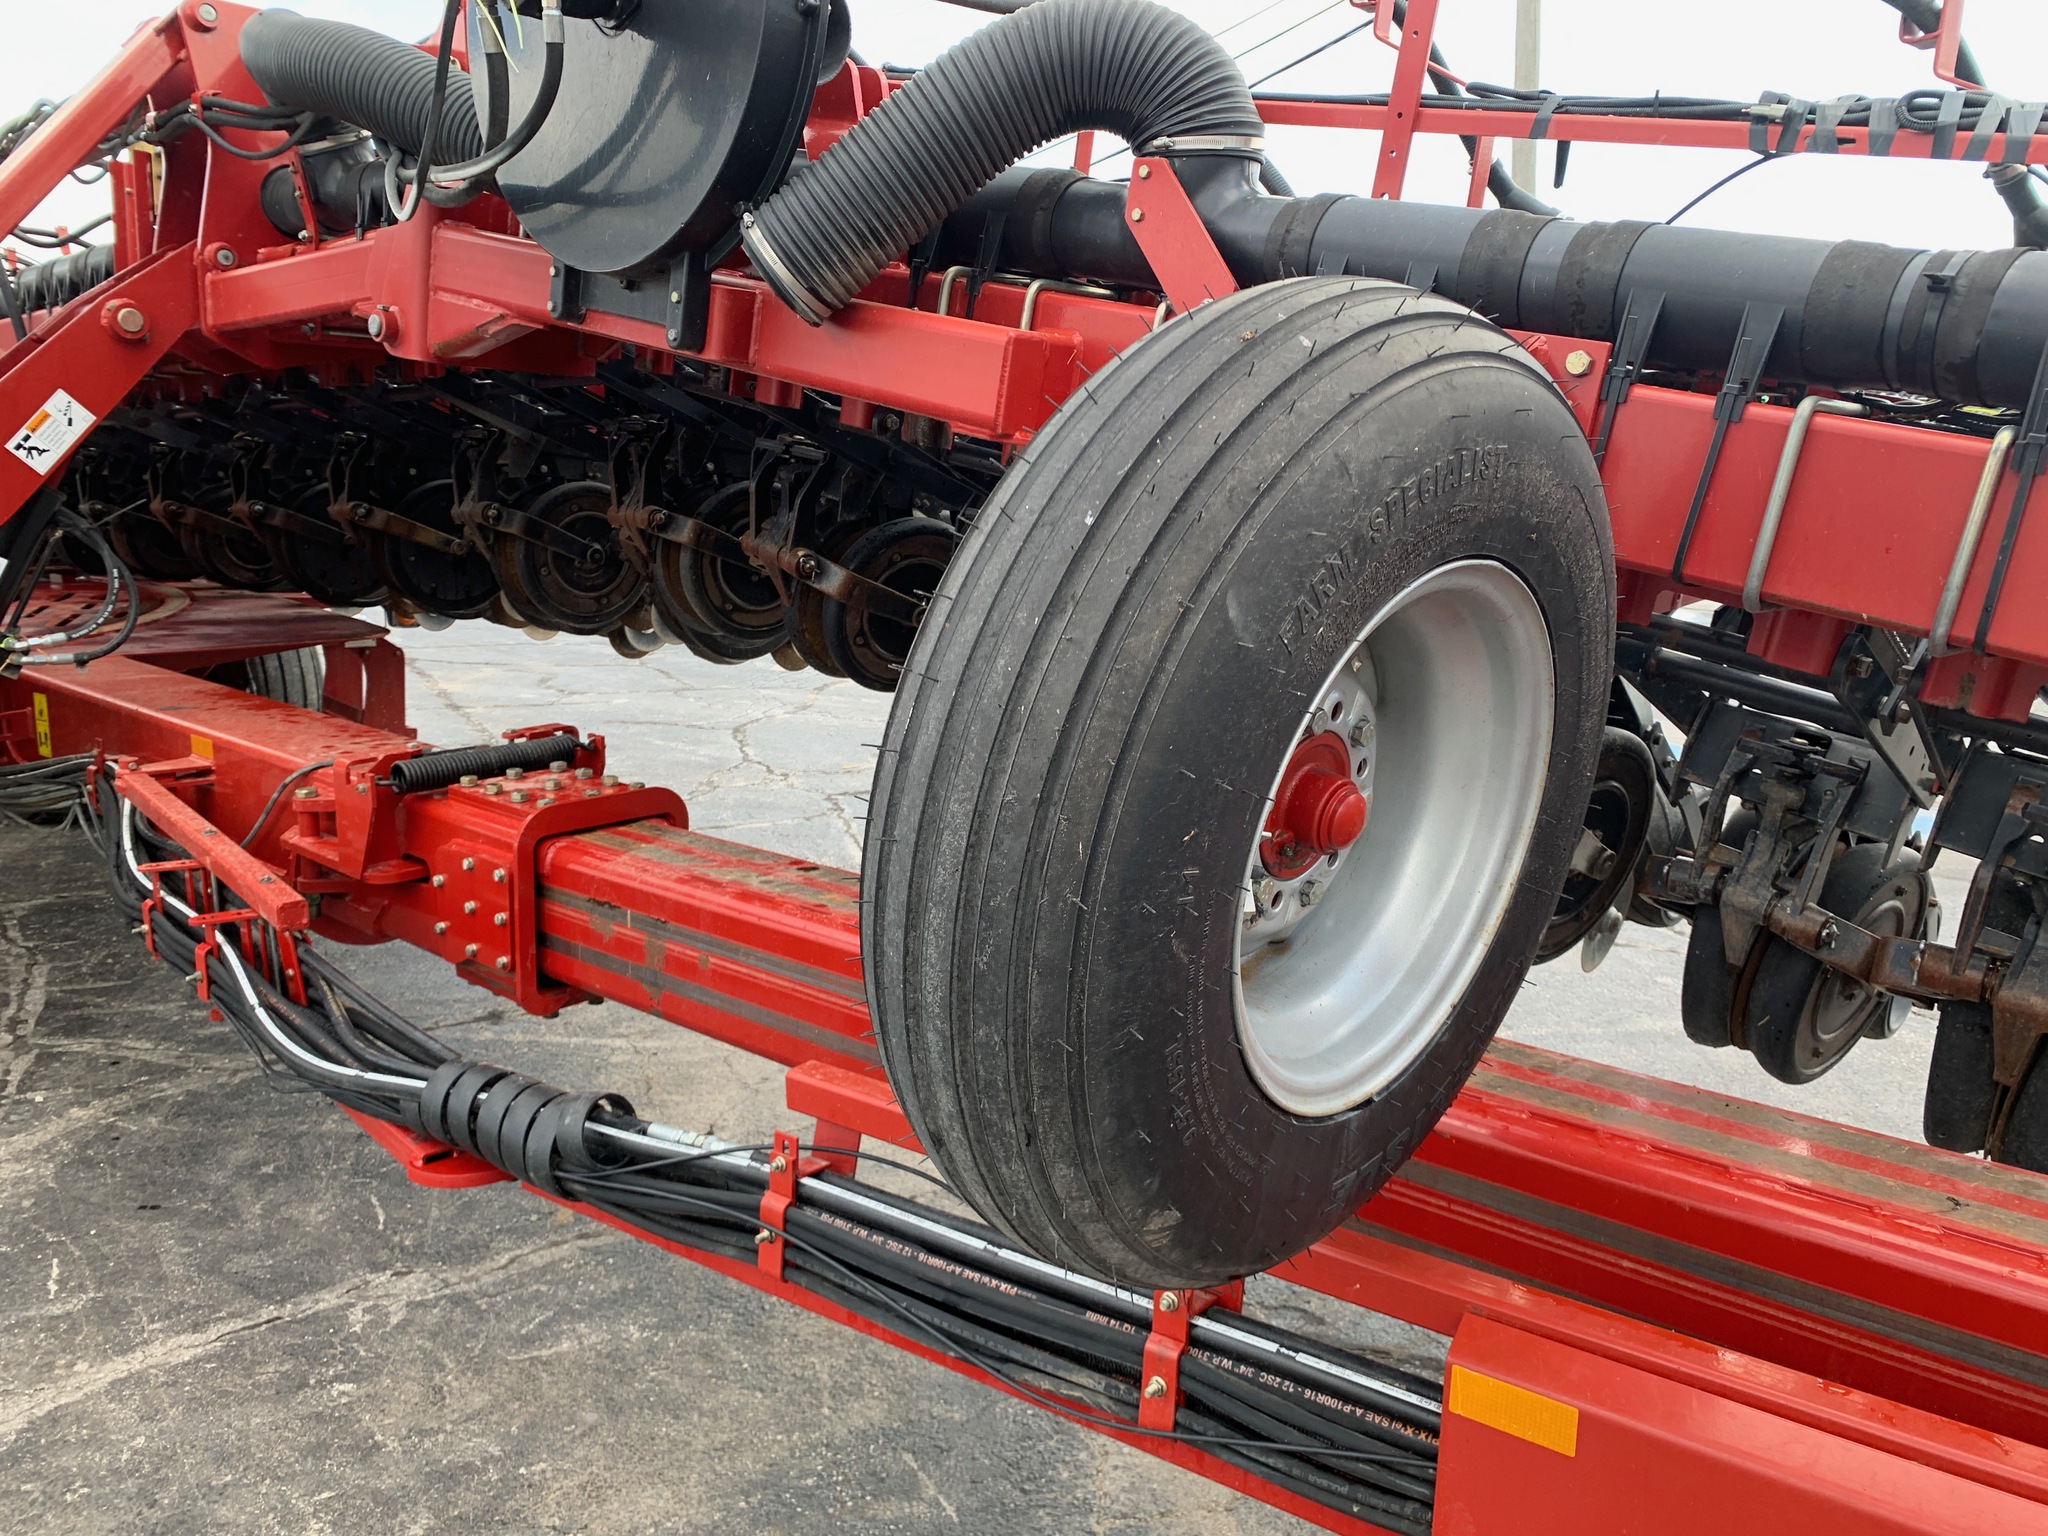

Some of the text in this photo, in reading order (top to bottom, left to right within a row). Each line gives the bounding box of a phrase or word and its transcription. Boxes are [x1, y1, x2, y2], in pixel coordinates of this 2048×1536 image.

[1278, 542, 1353, 655] FARM
[1368, 444, 1508, 540] SPECIALIST
[818, 1211, 835, 1225] PSI
[830, 1216, 853, 1233] 3100
[849, 1224, 869, 1240] W.P.
[883, 1238, 904, 1254] 2SC
[901, 1245, 913, 1258] 12
[915, 1250, 963, 1276] A-P100R16
[960, 1267, 982, 1283] SAE
[979, 1274, 1018, 1296] PIX-X'el
[1082, 1308, 1109, 1326] India
[1209, 1353, 1234, 1370] W.P.
[1256, 1370, 1282, 1388] 2SC
[1280, 1378, 1296, 1393] 12
[1301, 1386, 1365, 1418] A-P100R16
[1363, 1409, 1391, 1427] SAE
